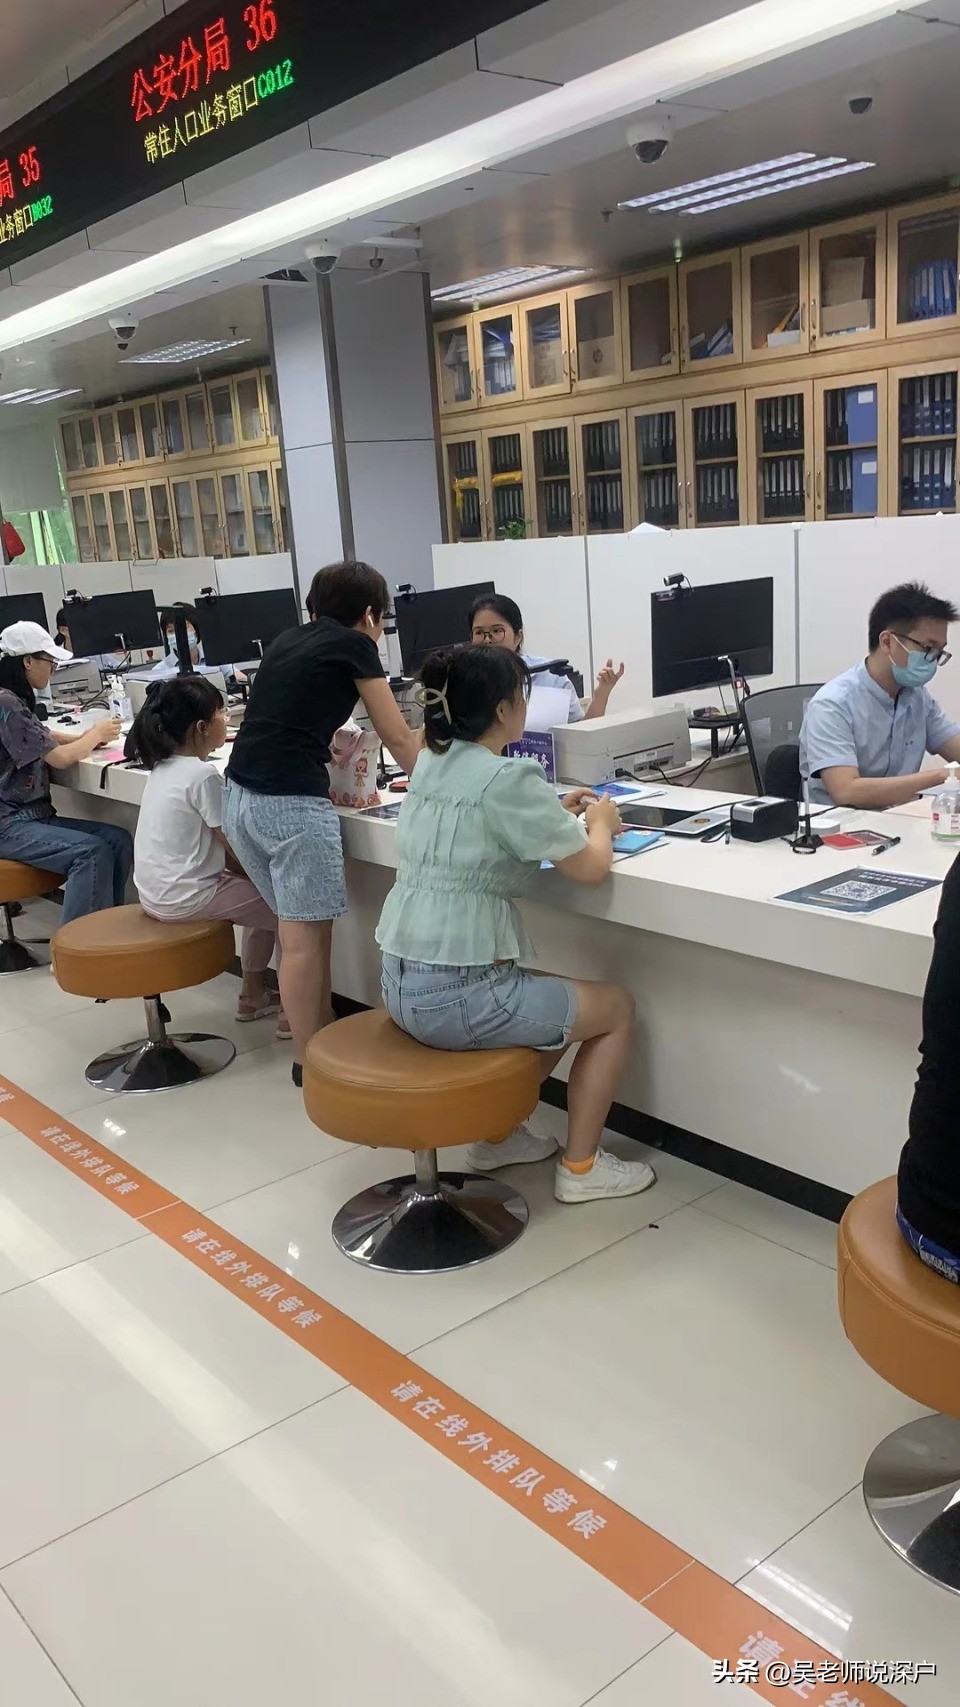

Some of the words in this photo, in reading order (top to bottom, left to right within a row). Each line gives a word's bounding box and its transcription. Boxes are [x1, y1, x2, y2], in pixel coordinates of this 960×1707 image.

[131, 17, 230, 122] 公安分局
[243, 0, 277, 51] 36
[144, 59, 294, 163] 常住人口业务窗口C012
[0, 159, 14, 207] 局
[19, 146, 40, 187] 35
[40, 1125, 140, 1195] 请在线外排队等候
[181, 1228, 322, 1328] 请在线外排队等候
[390, 1380, 607, 1539] 请在线外排队等候
